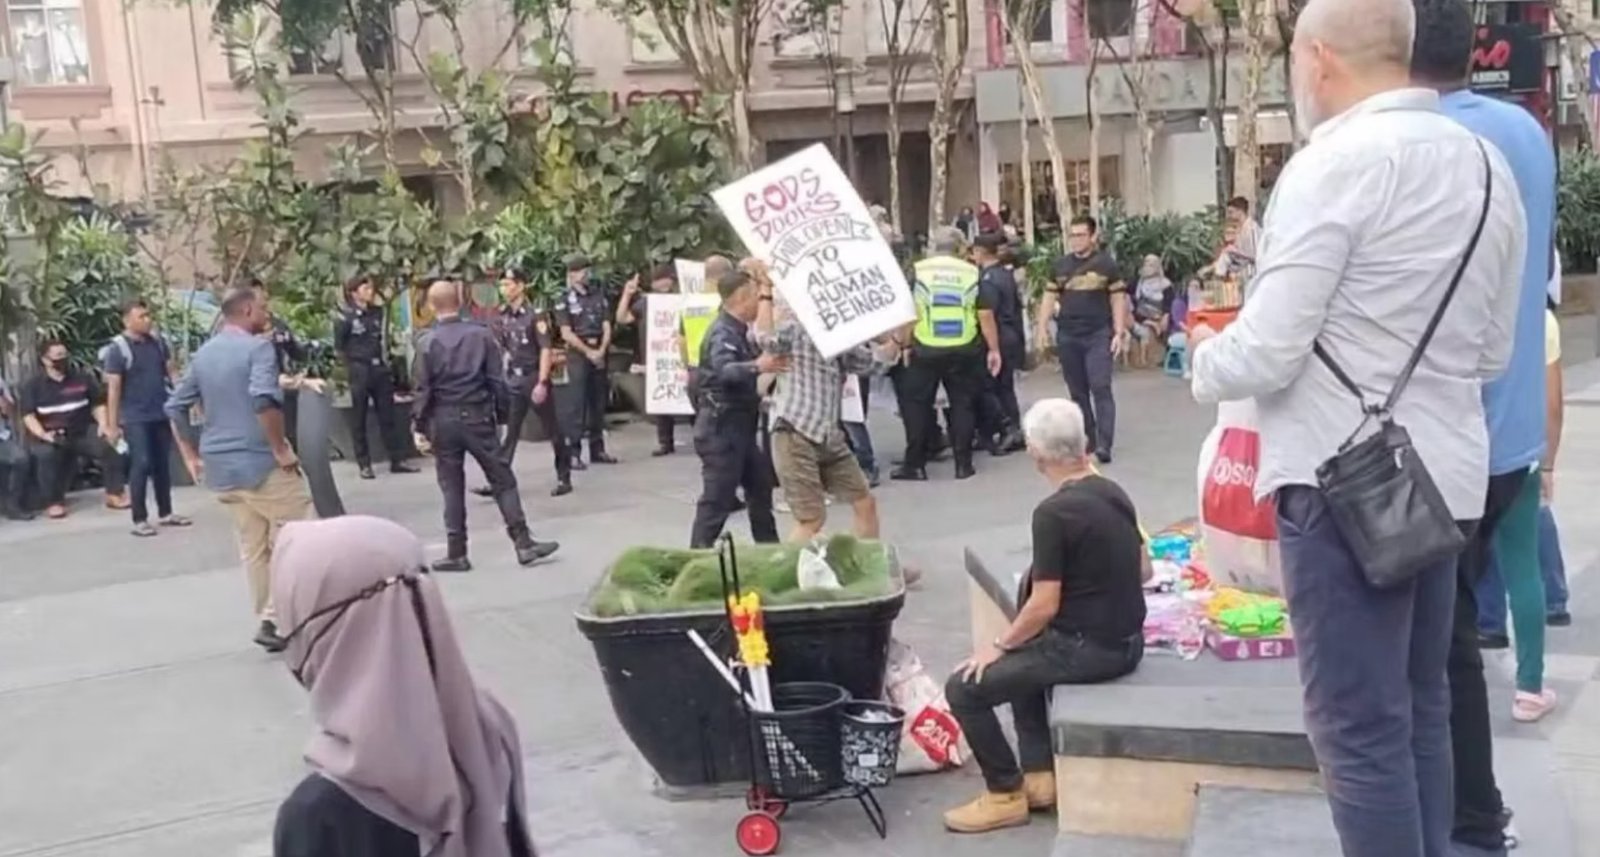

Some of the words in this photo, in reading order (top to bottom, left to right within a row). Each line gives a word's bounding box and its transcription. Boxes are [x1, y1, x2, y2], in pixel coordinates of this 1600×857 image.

[744, 167, 820, 222] GODS
[752, 192, 841, 244] DOORS
[802, 217, 849, 242] OPEN
[806, 244, 839, 267] TO
[806, 260, 862, 294] ALL
[811, 263, 887, 310] HUMAN
[818, 283, 897, 331] BEINGS
